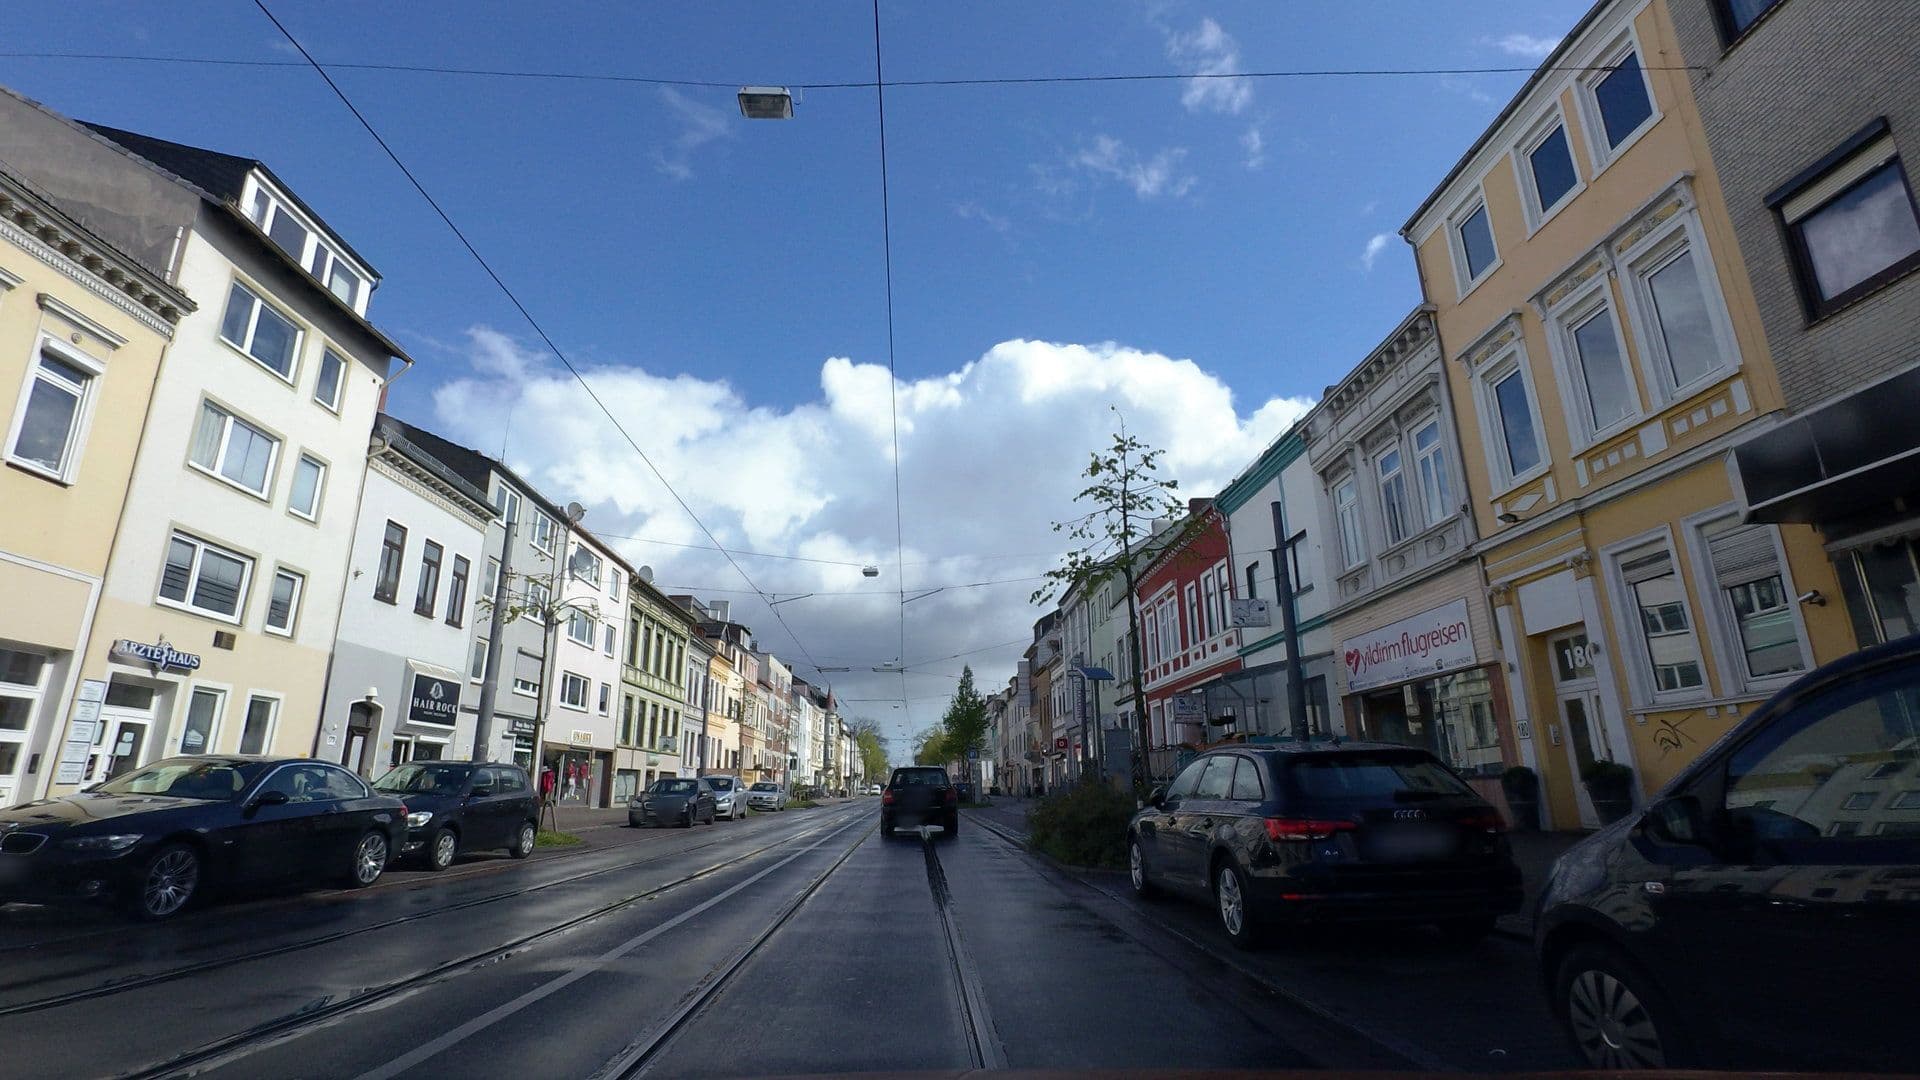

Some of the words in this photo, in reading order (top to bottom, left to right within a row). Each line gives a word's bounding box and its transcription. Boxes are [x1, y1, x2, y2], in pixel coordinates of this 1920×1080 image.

[168, 652, 199, 667] HAUS
[413, 697, 435, 710] HAIR
[436, 701, 457, 714] ROCK
